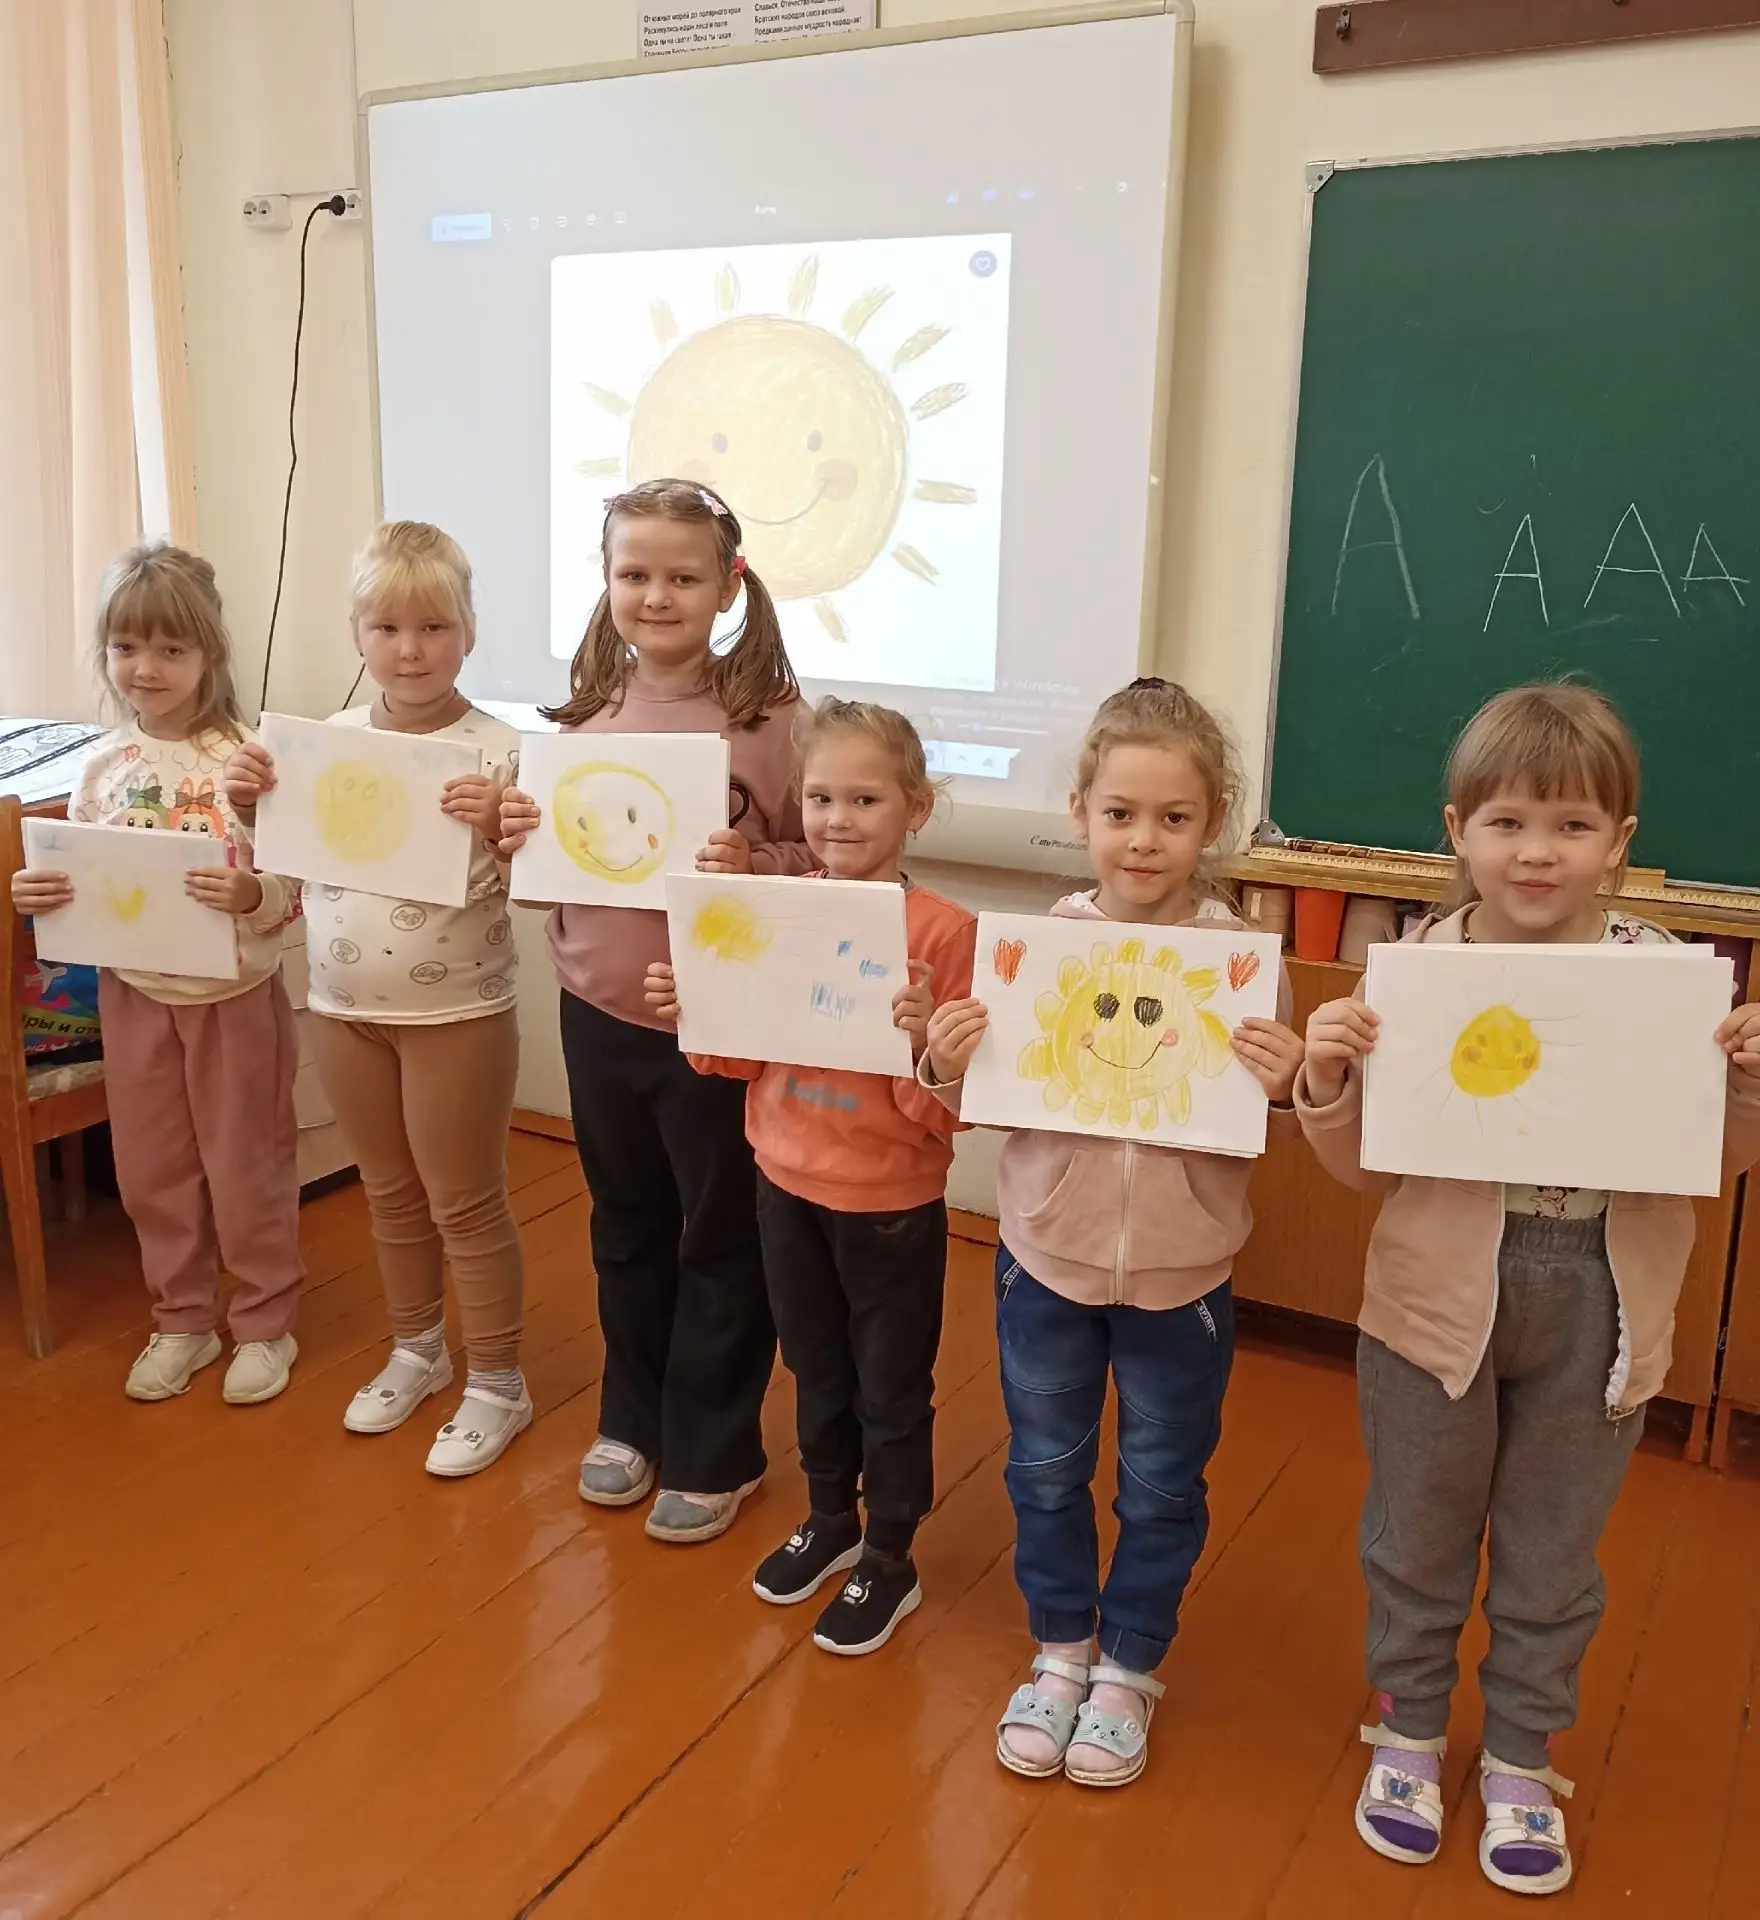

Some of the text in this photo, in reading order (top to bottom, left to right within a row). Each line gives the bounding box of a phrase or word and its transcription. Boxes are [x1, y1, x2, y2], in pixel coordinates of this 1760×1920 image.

[1331, 452, 1750, 632] А А А А
[59, 1023, 72, 1033] и
